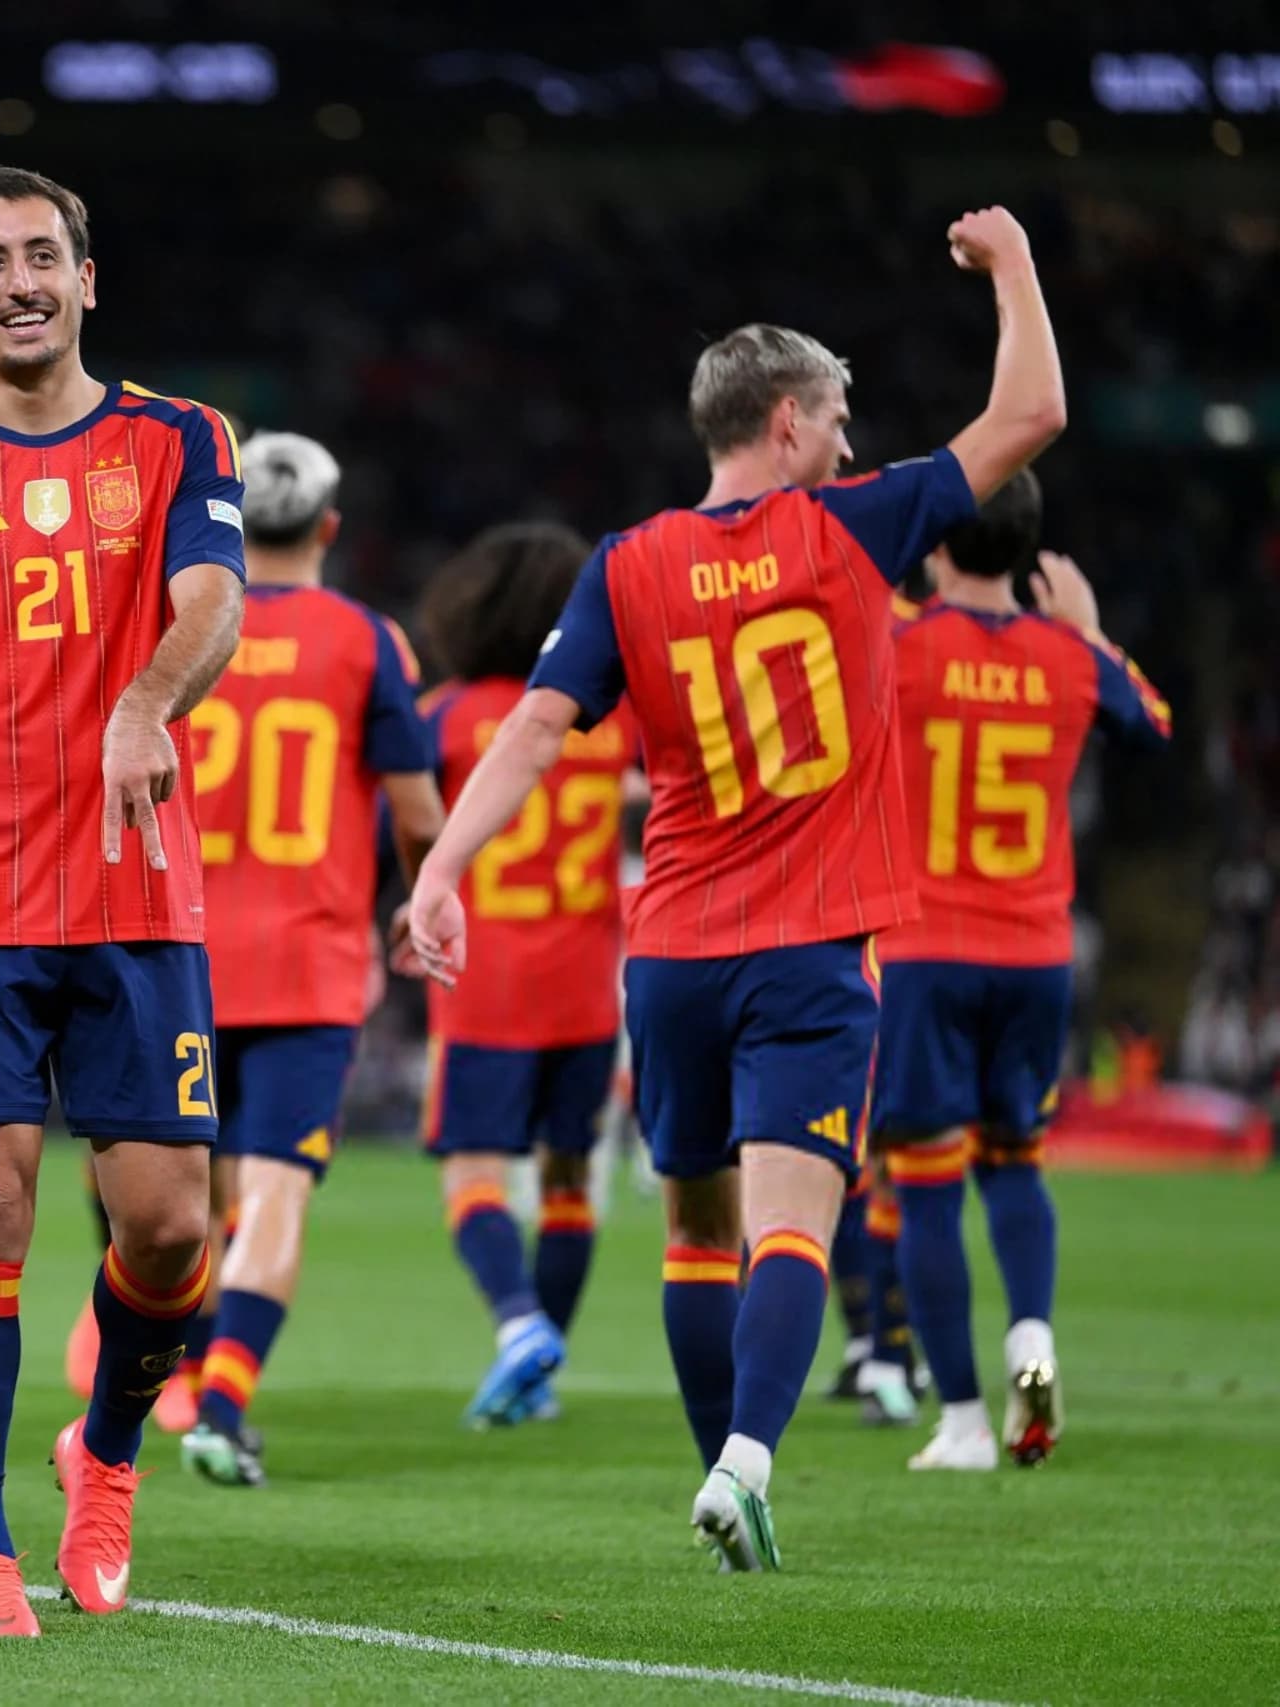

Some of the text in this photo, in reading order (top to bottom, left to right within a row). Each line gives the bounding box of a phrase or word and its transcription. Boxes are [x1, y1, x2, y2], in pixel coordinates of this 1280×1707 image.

[14, 550, 91, 641] 21
[690, 553, 779, 602] OLMO
[191, 697, 339, 866] 20
[669, 607, 851, 818] 10
[472, 772, 624, 918] 22
[923, 718, 1054, 878] 15
